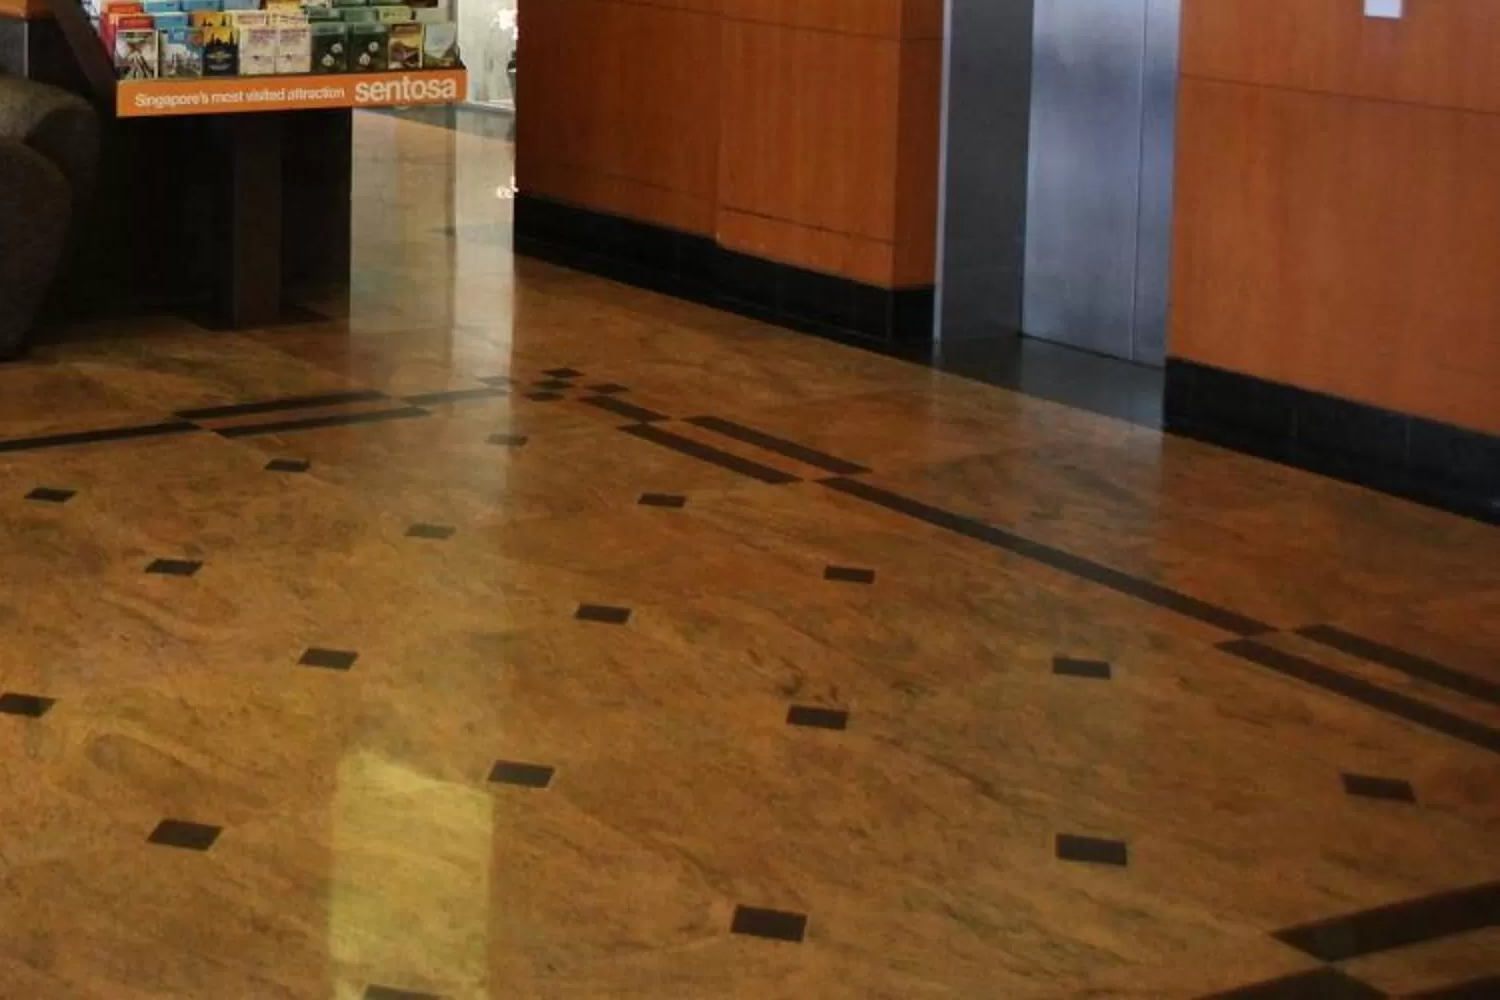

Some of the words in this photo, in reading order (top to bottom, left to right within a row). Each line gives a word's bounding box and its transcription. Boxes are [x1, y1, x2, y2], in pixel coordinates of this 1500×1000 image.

[134, 91, 209, 108] Singapore's
[211, 91, 244, 105] most
[245, 87, 285, 102] visited
[287, 86, 345, 101] attraction
[354, 75, 457, 103] sentosa
